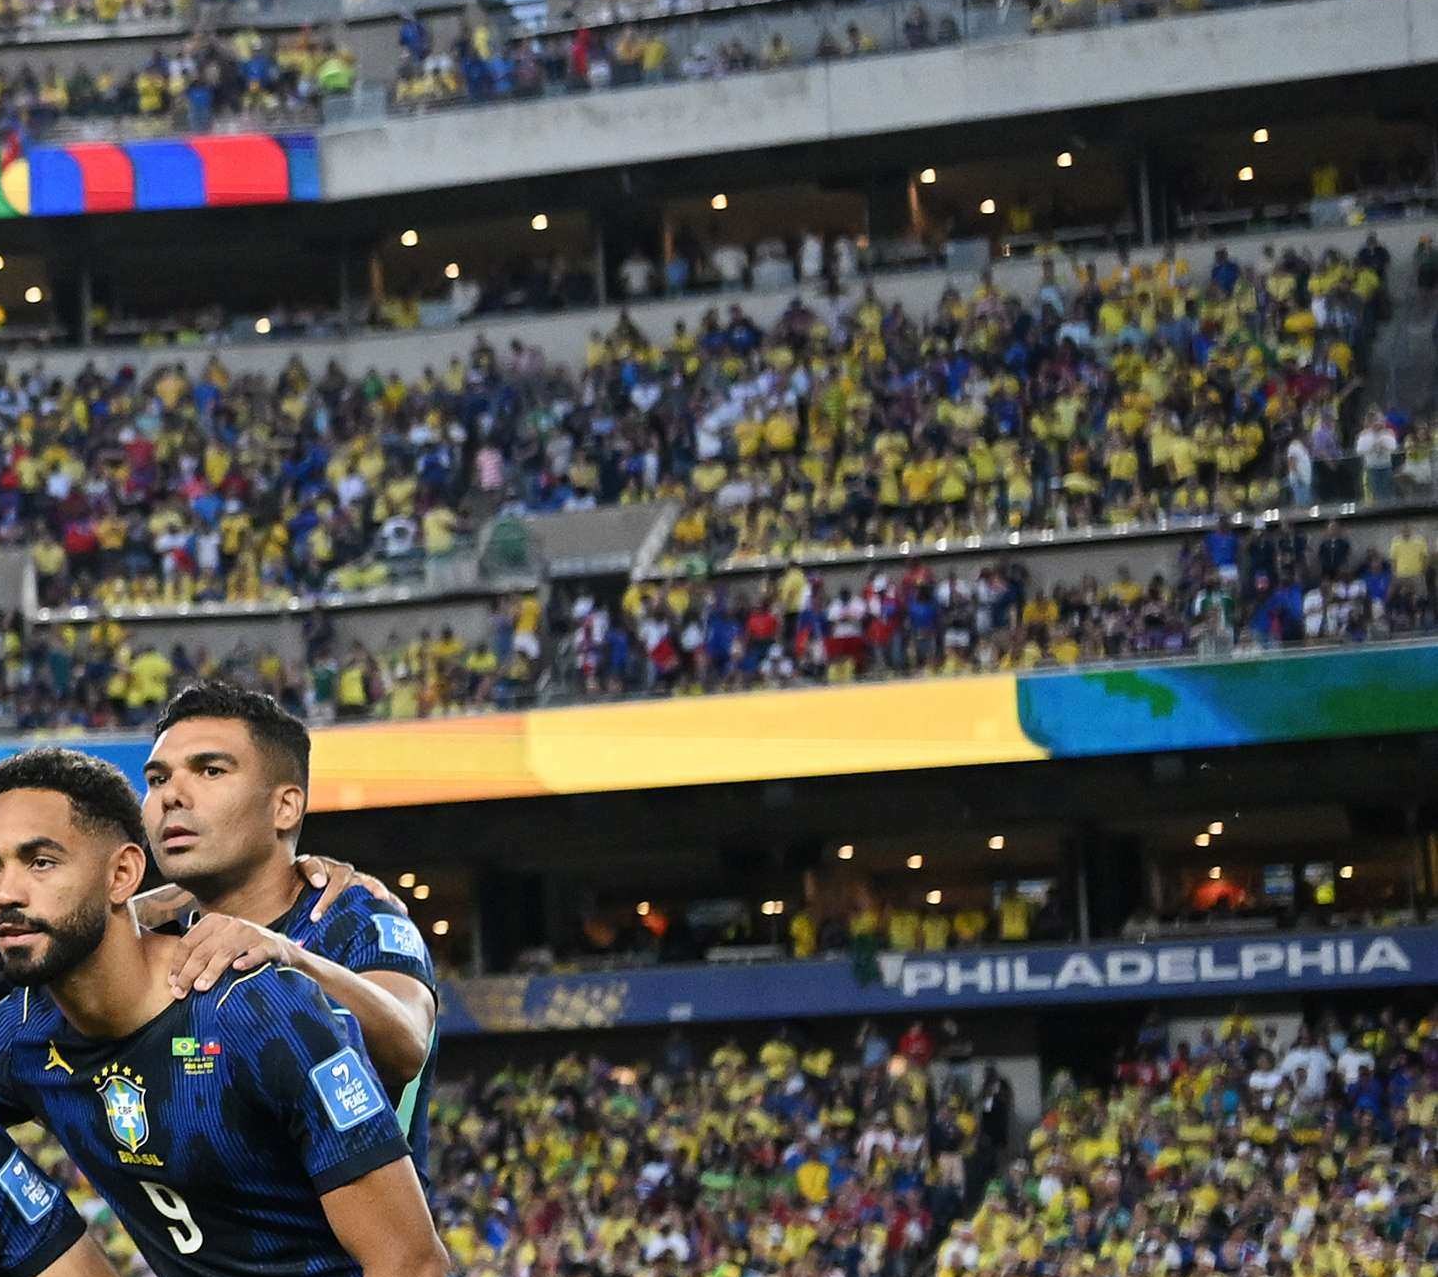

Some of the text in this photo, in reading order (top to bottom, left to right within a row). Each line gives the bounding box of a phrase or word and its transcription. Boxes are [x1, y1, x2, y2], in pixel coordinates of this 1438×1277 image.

[902, 935, 1411, 997] PHILADELPHIA
[118, 1150, 164, 1166] BRASIL
[140, 1180, 204, 1255] 9
